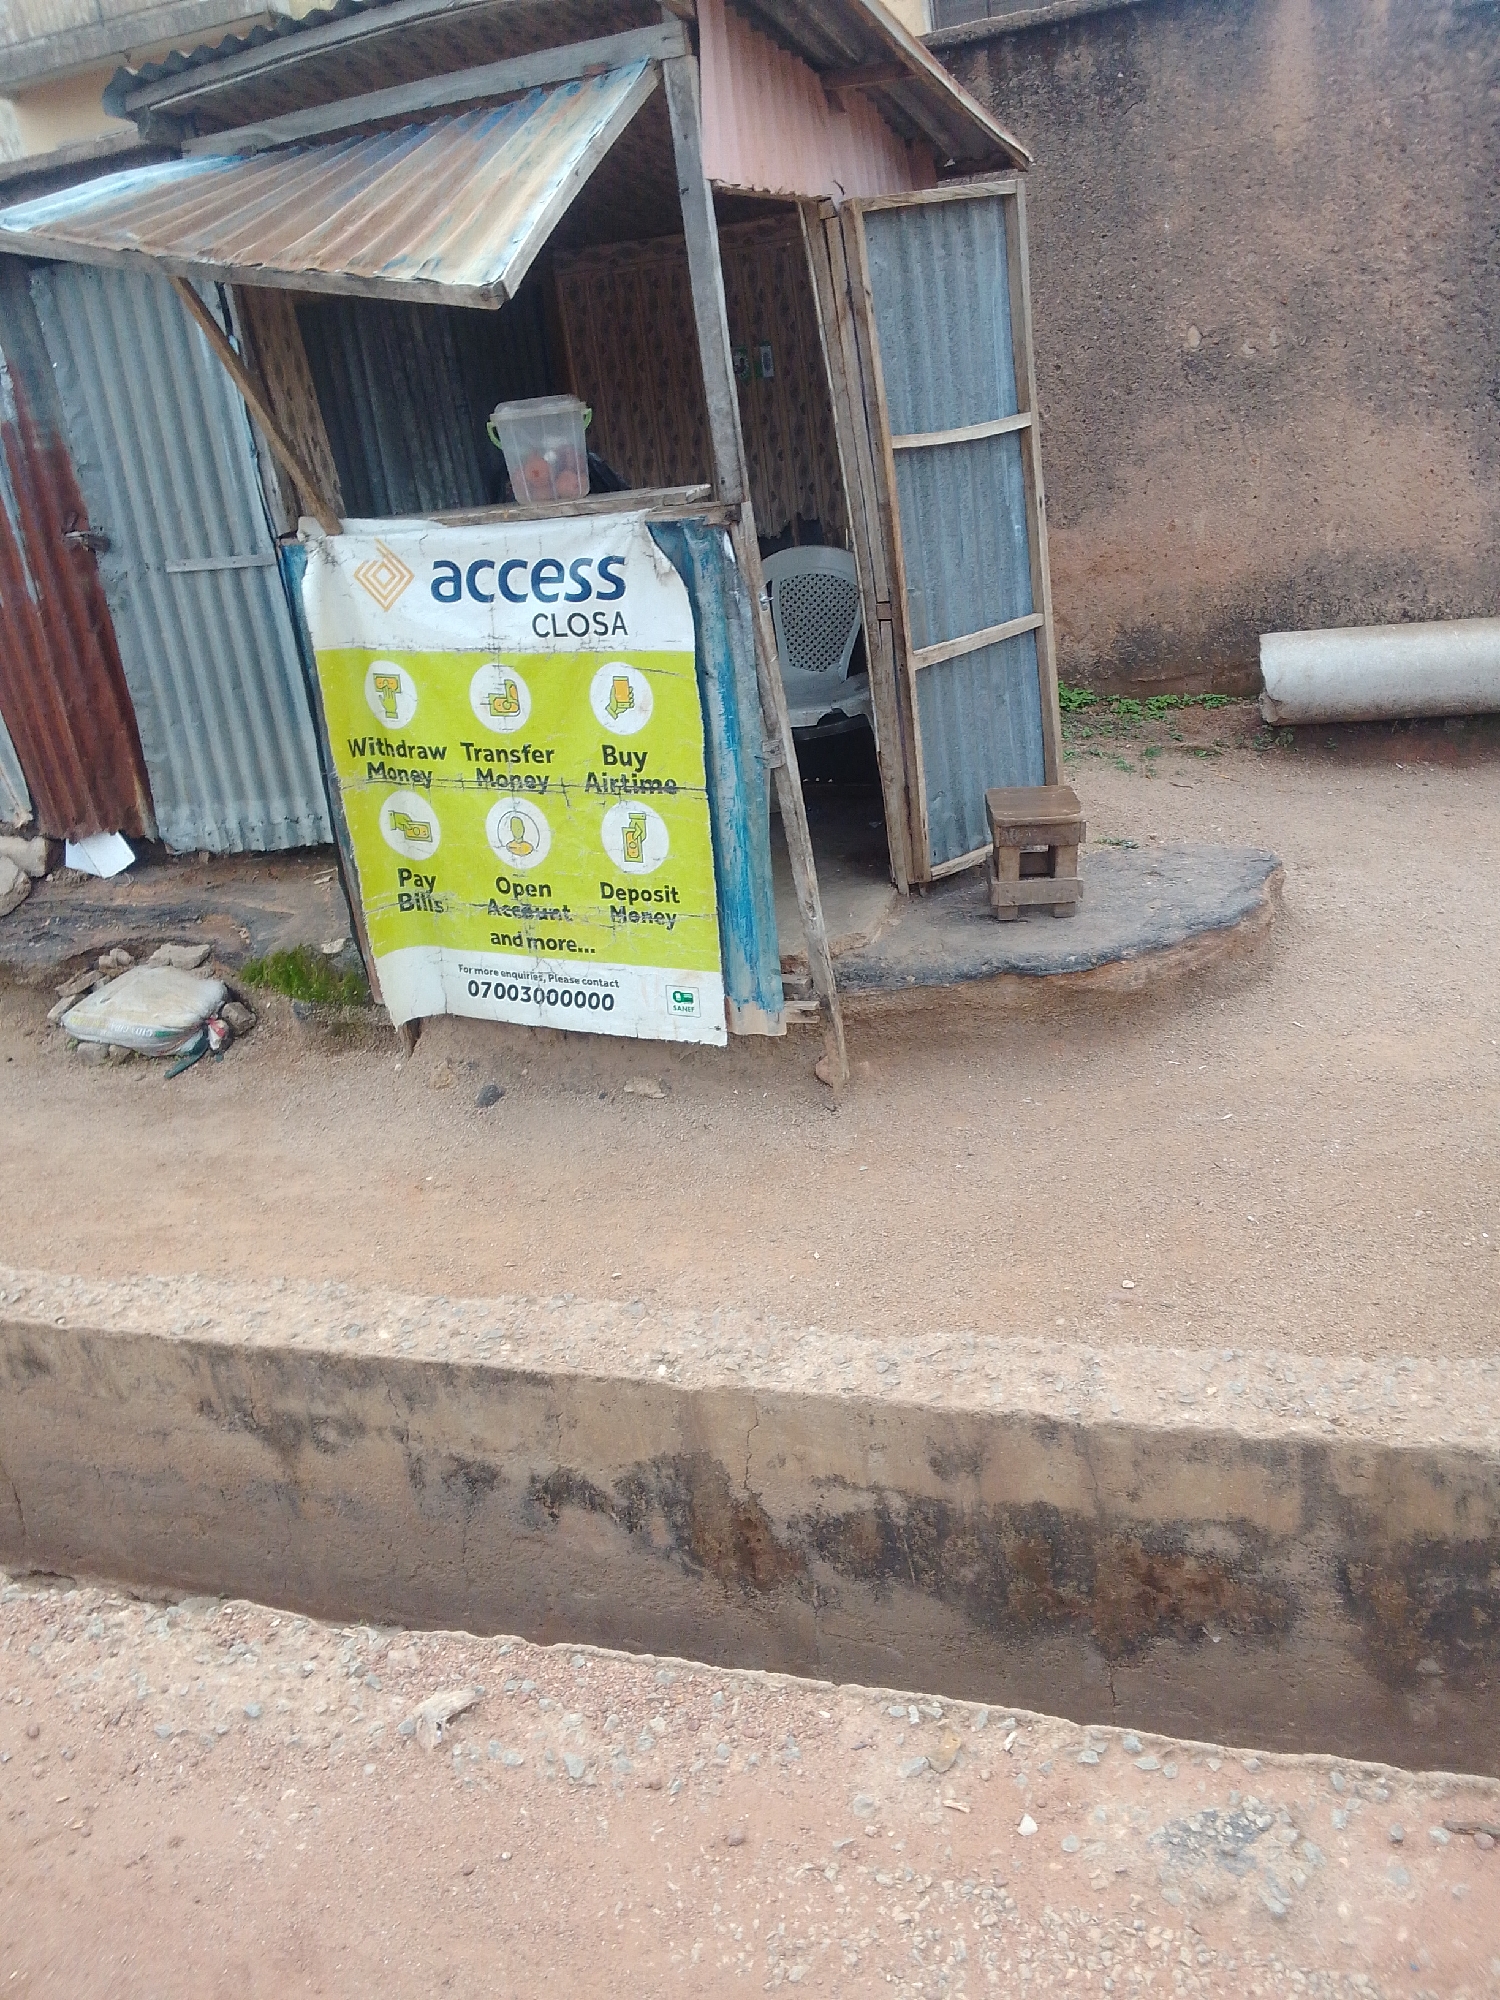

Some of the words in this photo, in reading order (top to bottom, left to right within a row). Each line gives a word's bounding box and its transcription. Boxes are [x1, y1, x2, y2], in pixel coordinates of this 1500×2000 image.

[430, 556, 627, 604] access
[532, 611, 628, 638] CLOSA
[347, 737, 447, 761] Withdraw
[460, 742, 555, 764] Transfer
[601, 744, 649, 773] Buy
[366, 761, 433, 788] Money
[476, 767, 550, 794] Money
[584, 772, 678, 795] Airtime
[397, 867, 437, 893] Pay
[495, 876, 552, 900] Open
[397, 892, 444, 913] Bills
[600, 882, 680, 904] Deposit
[487, 898, 573, 922] Account
[609, 905, 678, 931] Money
[490, 931, 523, 948] and
[526, 934, 596, 954] more...
[458, 963, 474, 974] For
[474, 967, 499, 977] more
[548, 973, 581, 986] Please
[582, 978, 620, 988] contact
[467, 979, 615, 1011] 07003000000
